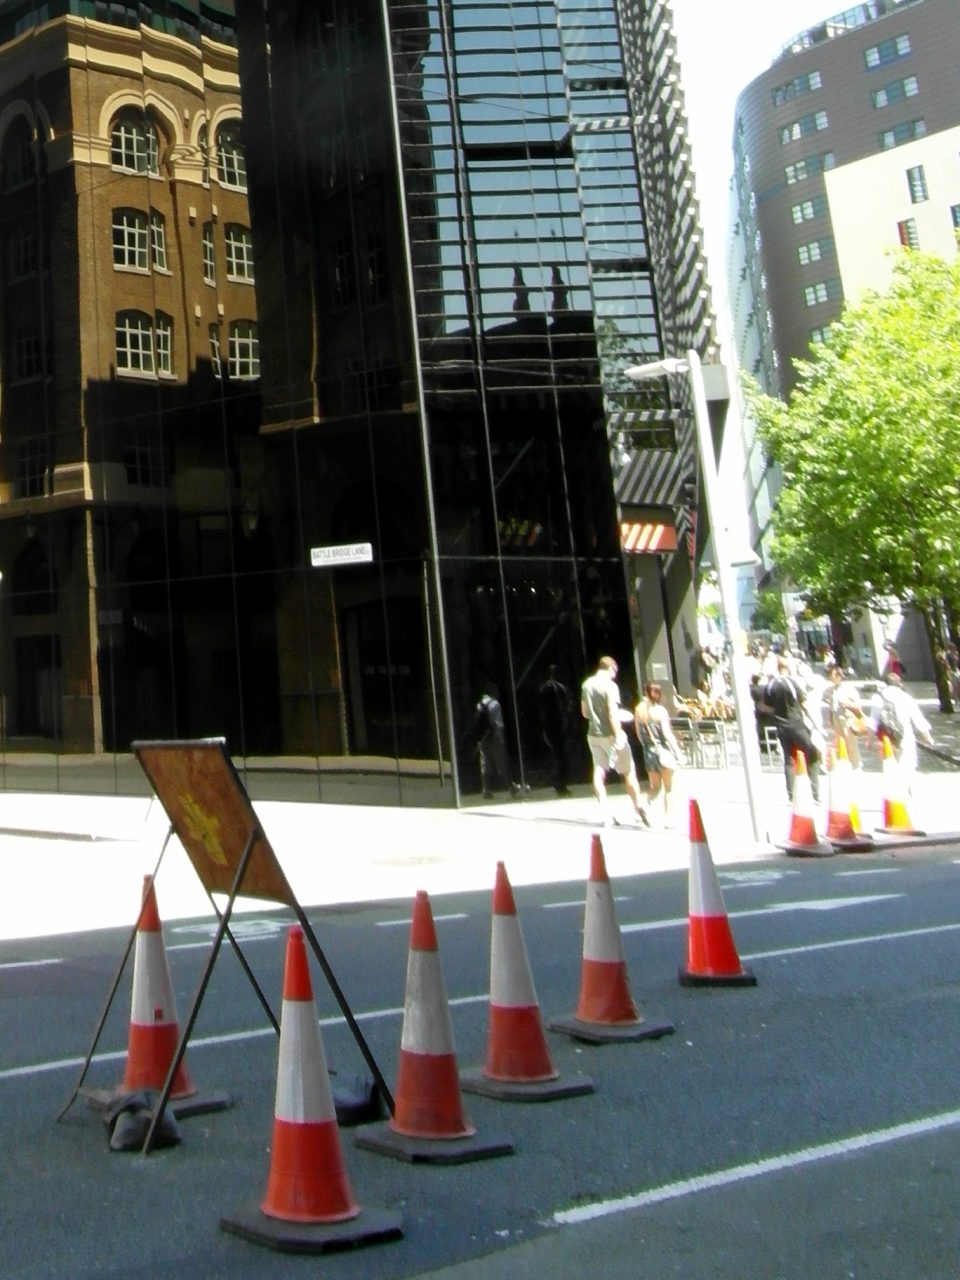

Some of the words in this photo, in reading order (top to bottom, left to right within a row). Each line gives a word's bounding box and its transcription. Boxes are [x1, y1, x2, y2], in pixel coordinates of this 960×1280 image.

[313, 549, 331, 560] BATTLE
[332, 547, 351, 558] BRIDGE
[352, 545, 365, 556] LANE
